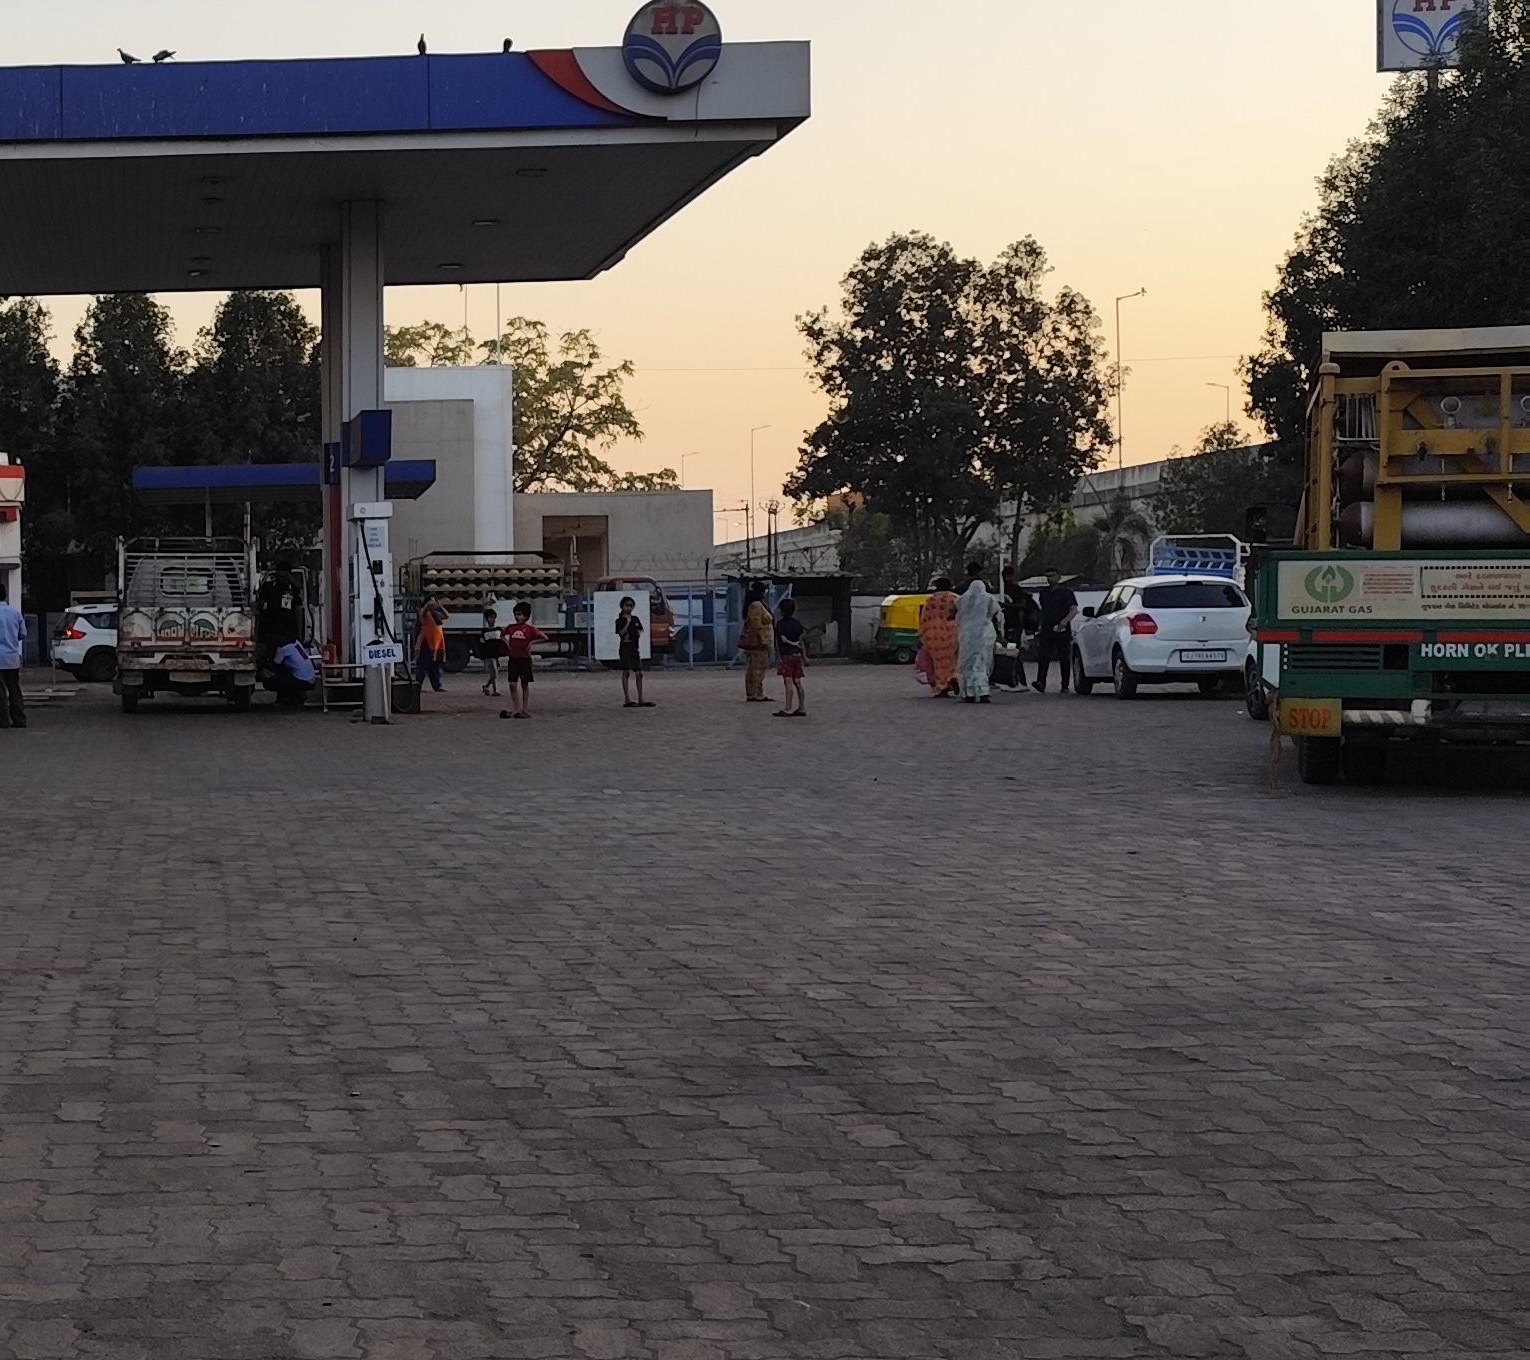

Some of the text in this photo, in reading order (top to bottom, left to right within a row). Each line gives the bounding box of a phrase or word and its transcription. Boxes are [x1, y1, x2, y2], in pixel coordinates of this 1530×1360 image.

[651, 5, 704, 35] HP
[1291, 605, 1373, 614] GUJARAT GAS
[368, 648, 397, 660] DIESEL
[1420, 643, 1469, 658] HORN
[1473, 643, 1500, 658] OK
[1289, 708, 1332, 729] STOP
